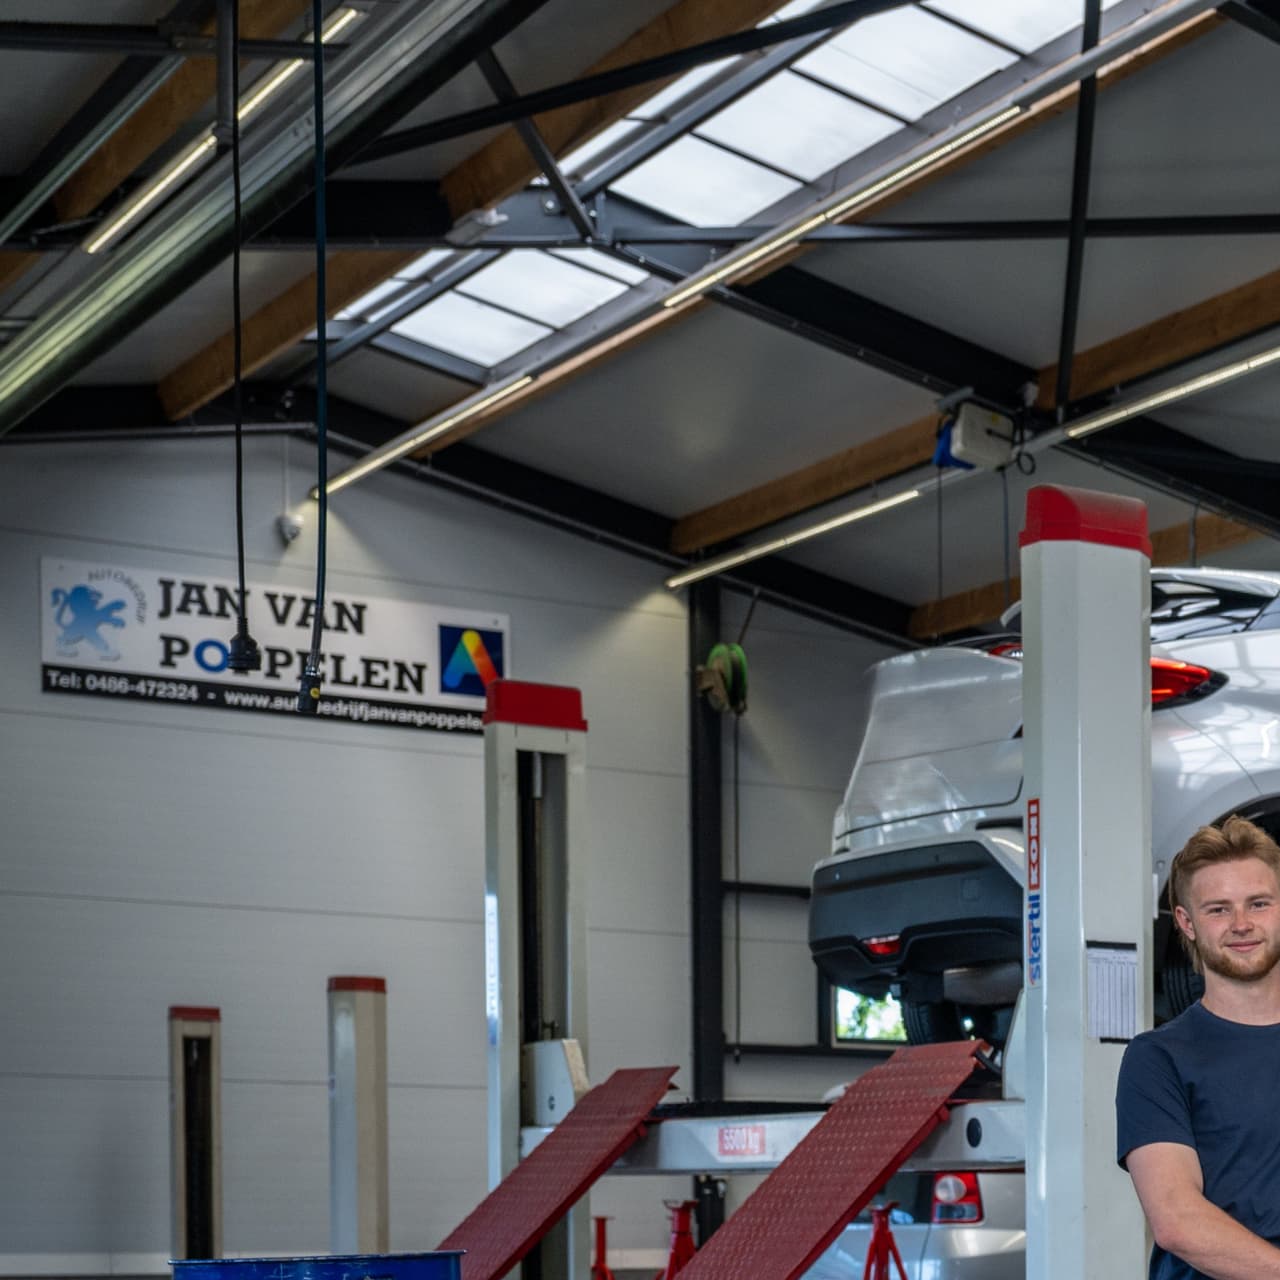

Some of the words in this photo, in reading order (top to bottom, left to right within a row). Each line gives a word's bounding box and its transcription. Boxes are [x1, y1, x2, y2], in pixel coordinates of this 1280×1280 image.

[158, 578, 250, 619] JAN
[264, 591, 367, 634] VAN
[48, 669, 81, 690] Tel:
[160, 634, 427, 693] POPELEN
[1029, 801, 1039, 887] KONI
